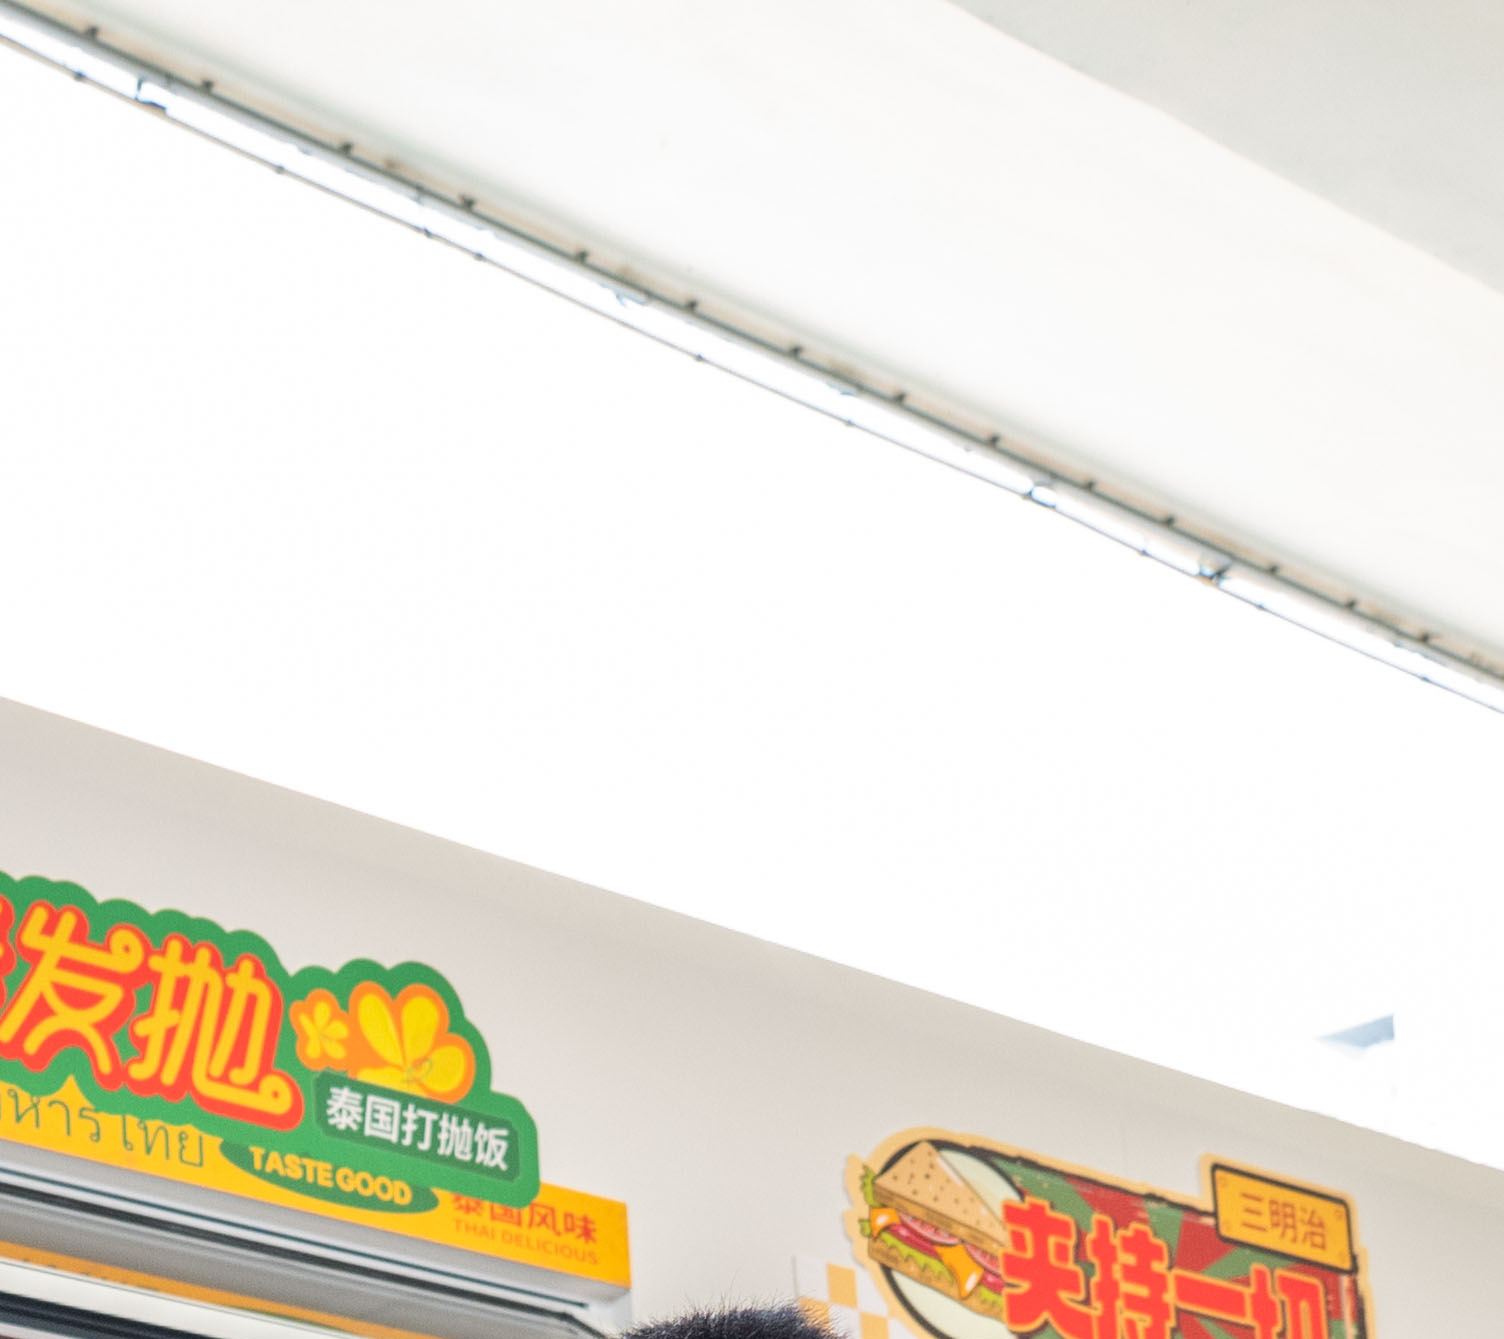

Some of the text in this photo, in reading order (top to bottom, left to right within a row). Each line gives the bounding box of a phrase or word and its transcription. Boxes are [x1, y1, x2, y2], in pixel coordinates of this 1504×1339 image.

[326, 1086, 509, 1172] 泰国打抛饭
[249, 1146, 413, 1206] TASTE GOOD
[453, 1218, 599, 1266] THAI DELICIOUS
[1239, 1187, 1329, 1251] 三明治
